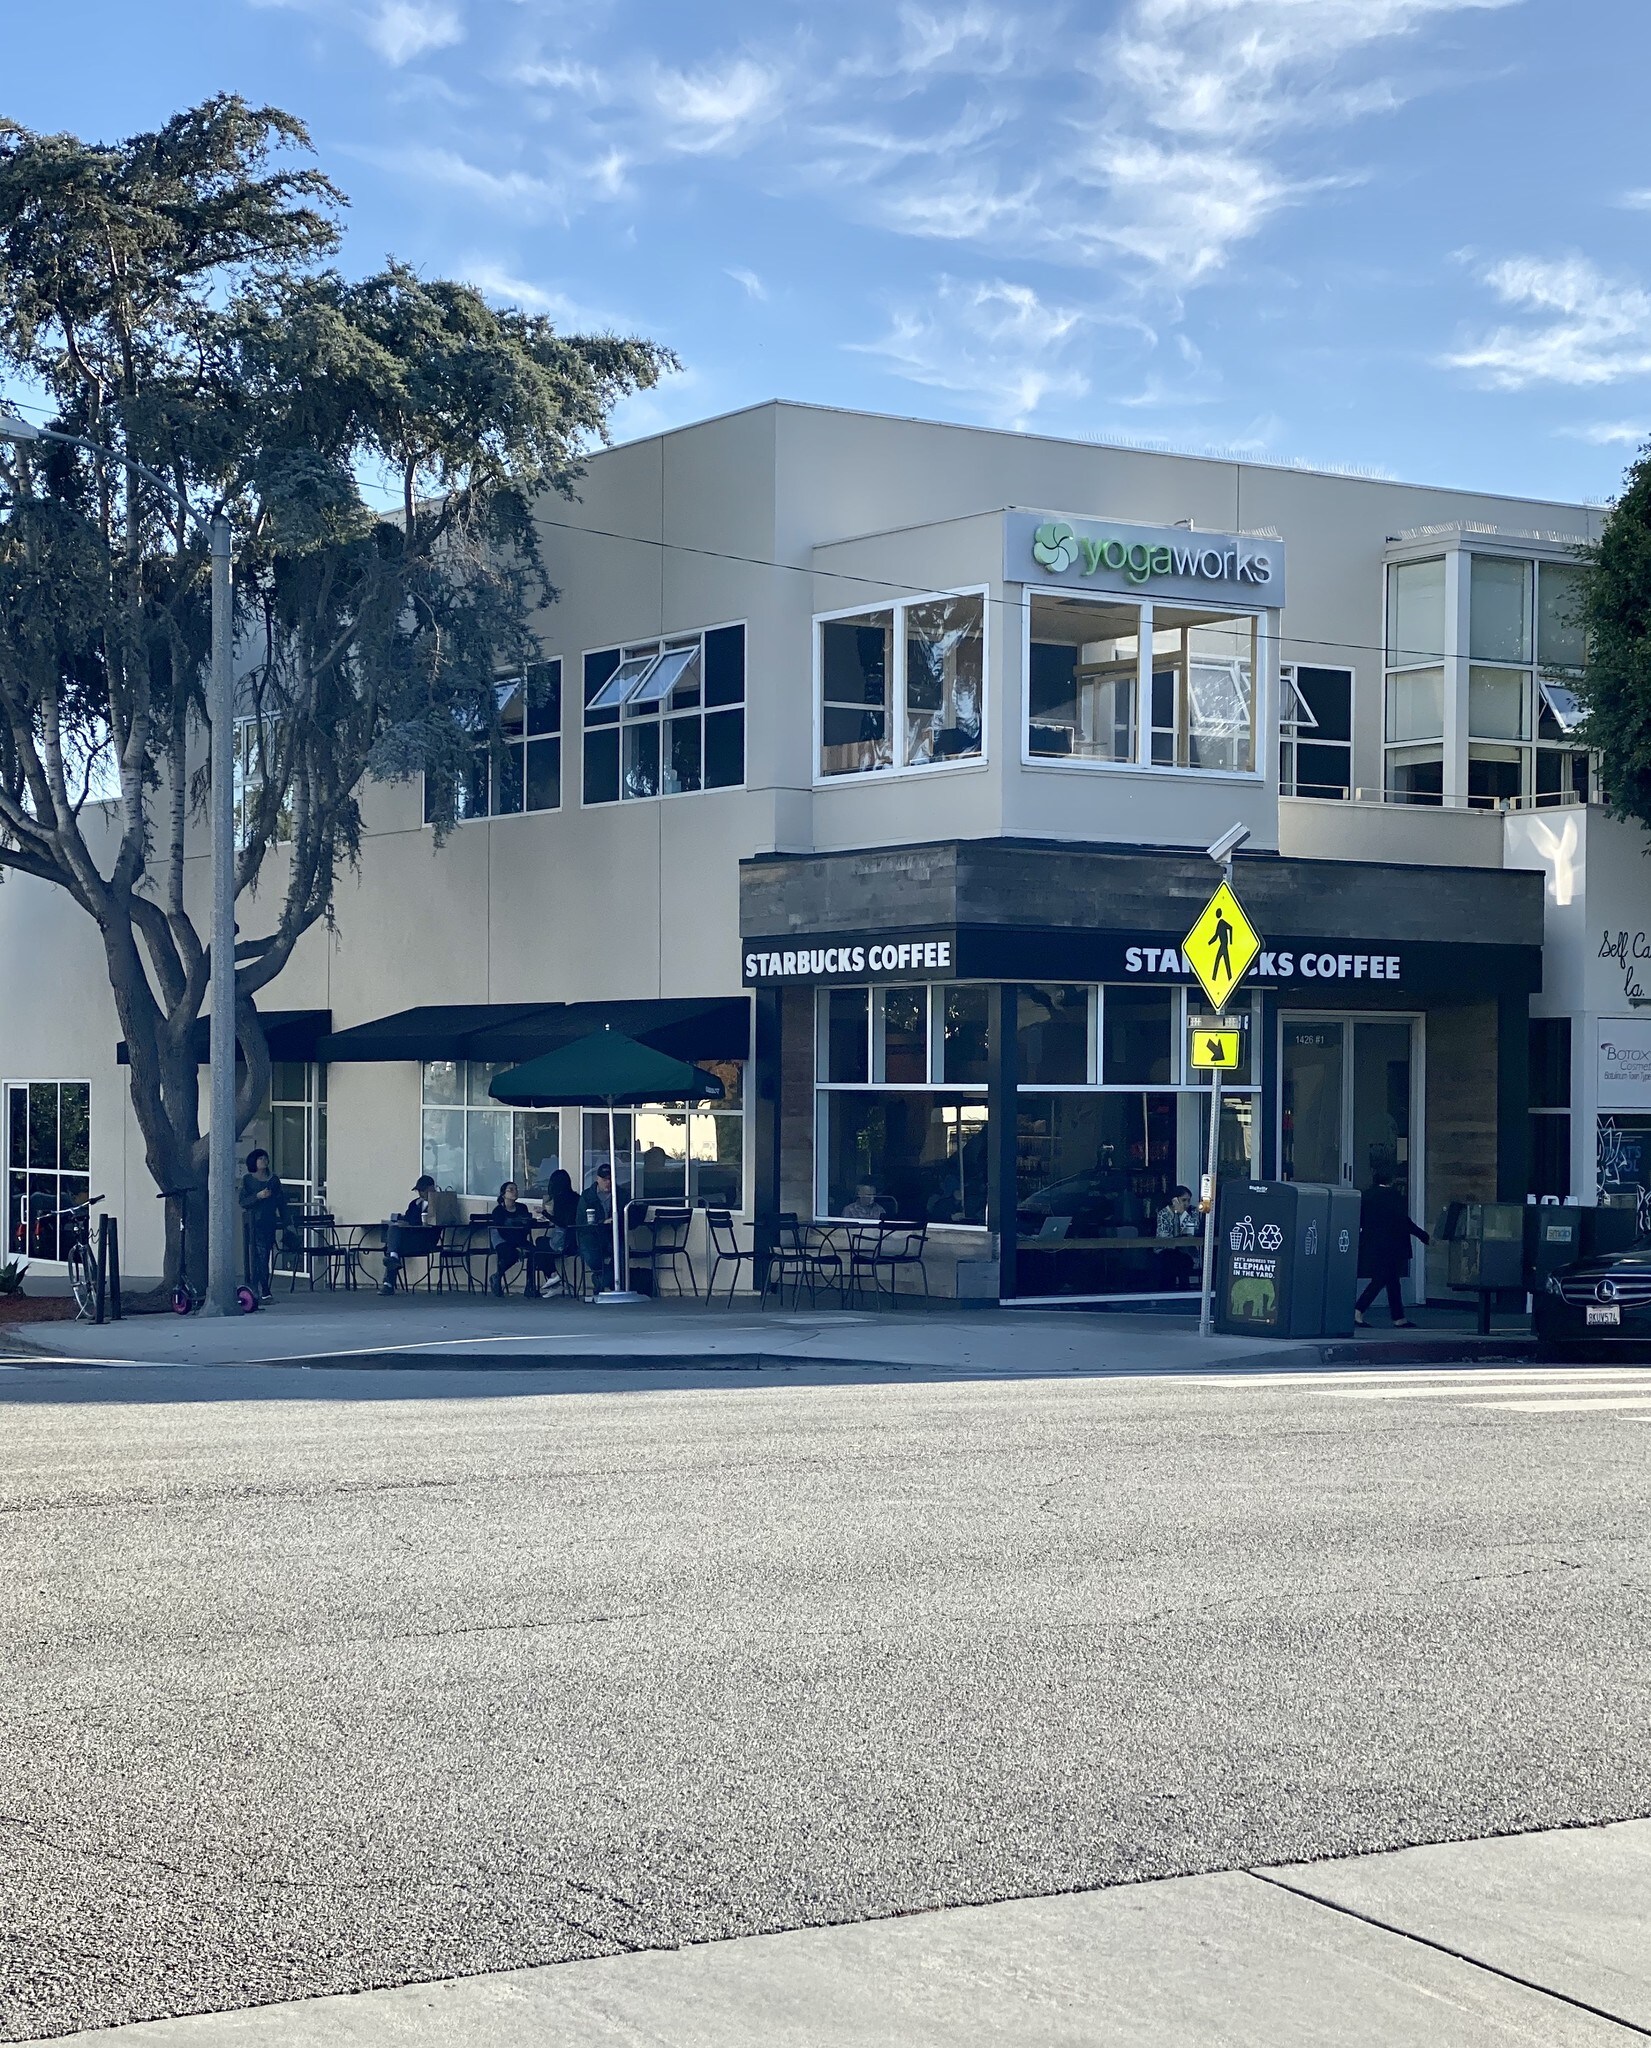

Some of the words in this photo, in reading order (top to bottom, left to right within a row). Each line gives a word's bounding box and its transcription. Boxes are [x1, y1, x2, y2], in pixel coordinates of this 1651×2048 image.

[1080, 537, 1272, 584] yogaworks
[745, 946, 865, 978] STARBUCKS
[868, 941, 951, 971] COFFEE
[1125, 947, 1294, 976] STAKS
[1299, 953, 1401, 980] COFFEE
[1598, 930, 1629, 970] Self
[1295, 1035, 1314, 1044] 1426
[1315, 1035, 1324, 1044] #1
[1233, 1262, 1276, 1272] ELEPHANT
[1255, 1271, 1275, 1279] YARD.
